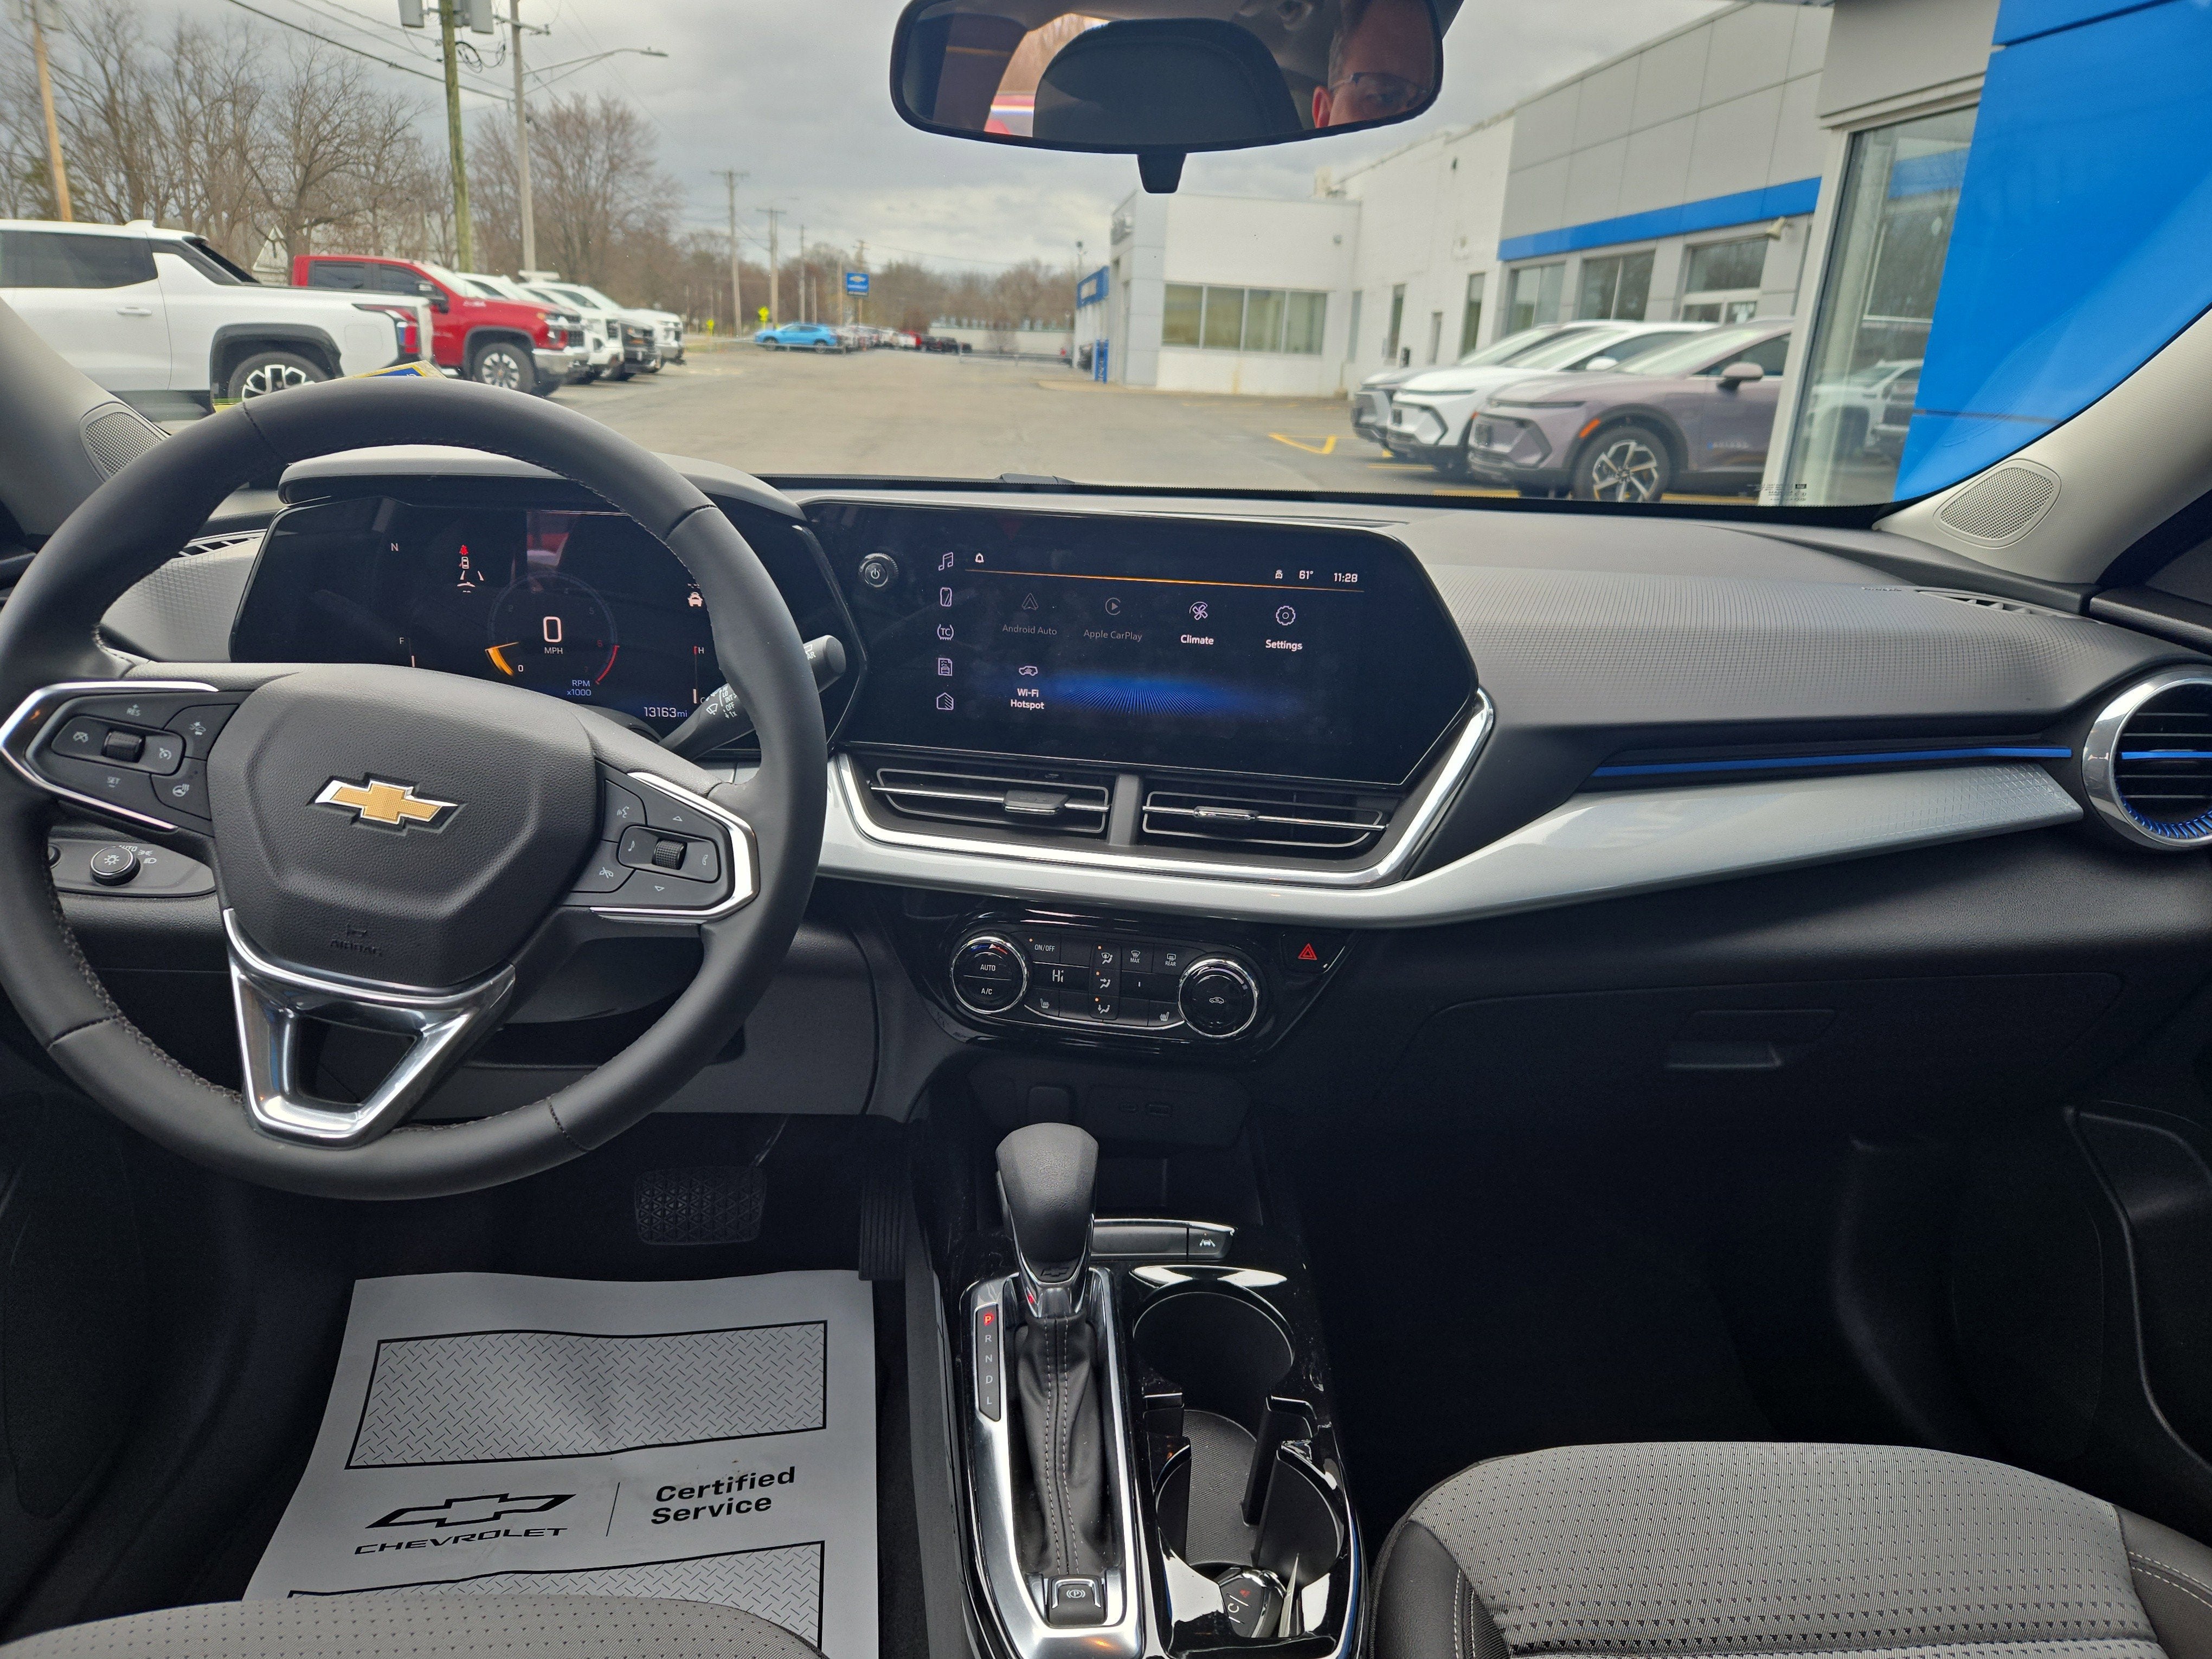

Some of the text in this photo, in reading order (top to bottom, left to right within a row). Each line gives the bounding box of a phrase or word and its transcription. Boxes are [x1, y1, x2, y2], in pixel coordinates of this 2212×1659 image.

[391, 543, 399, 551] N
[1334, 573, 1358, 583] 11:28
[543, 616, 562, 642] 0
[941, 628, 951, 636] TC
[1002, 624, 1057, 635] Android Auto
[1084, 629, 1142, 642] Apple CarPlay
[1180, 634, 1214, 645] Climate
[1265, 639, 1303, 651] Settings
[1017, 688, 1039, 698] Wi-Fi
[725, 702, 735, 711] OFF
[1011, 699, 1045, 711] Hotspot
[984, 1314, 993, 1324] P
[985, 1334, 992, 1343] R
[985, 1354, 993, 1363] N
[986, 1375, 993, 1384] D
[987, 1396, 992, 1405] L
[655, 1466, 795, 1502] Certified
[651, 1497, 771, 1524] Service
[355, 1528, 568, 1555] CHEVROLET
